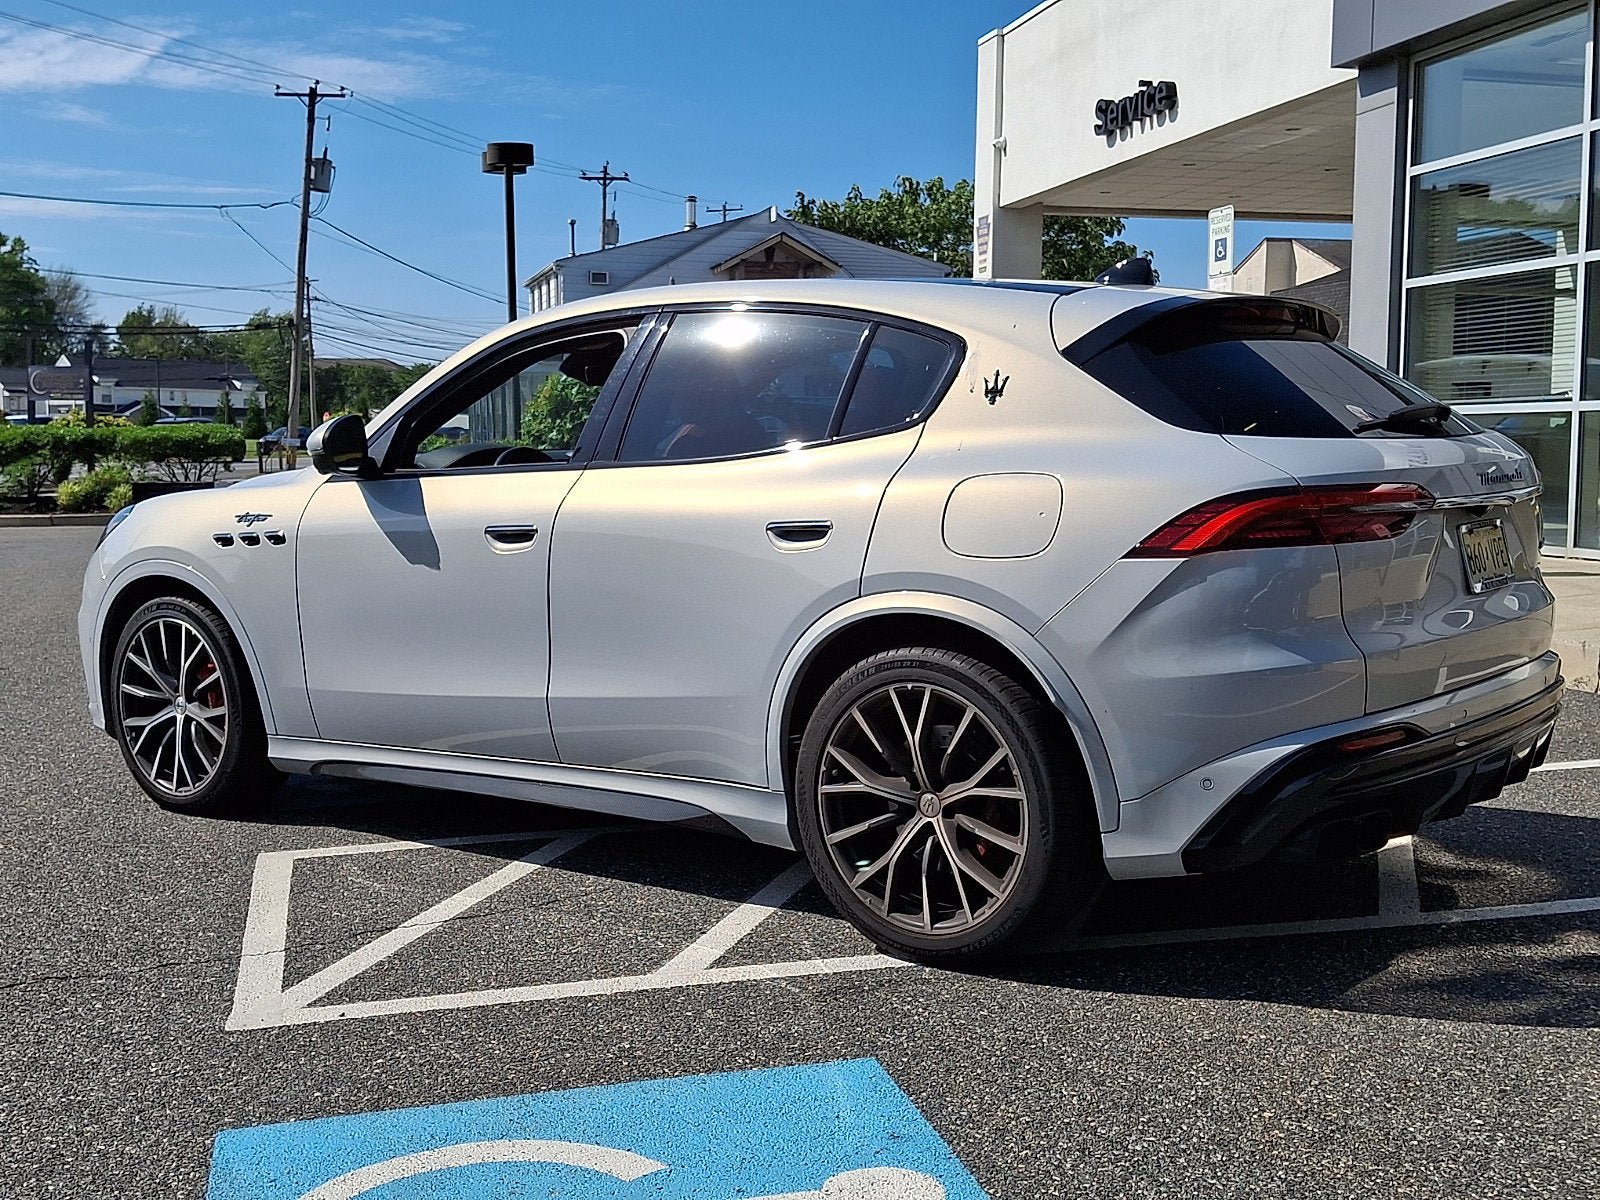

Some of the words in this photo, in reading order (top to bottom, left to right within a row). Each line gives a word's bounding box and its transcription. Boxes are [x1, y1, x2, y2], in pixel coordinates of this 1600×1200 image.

[1094, 80, 1178, 136] Service
[1210, 213, 1232, 225] RESERVED
[1212, 225, 1231, 237] PARKING
